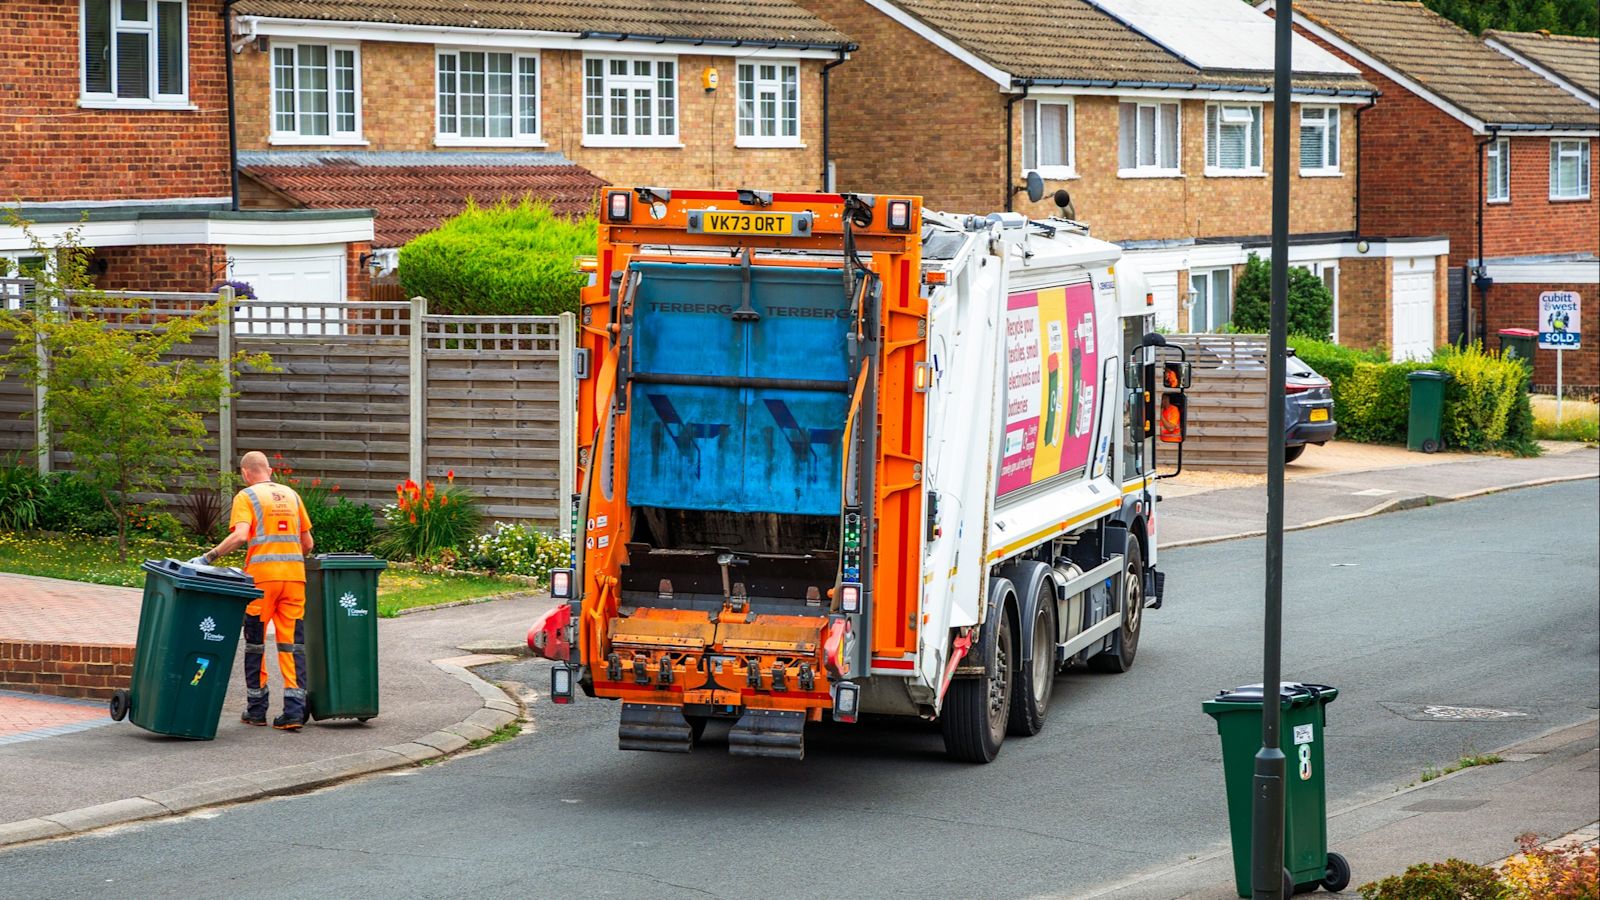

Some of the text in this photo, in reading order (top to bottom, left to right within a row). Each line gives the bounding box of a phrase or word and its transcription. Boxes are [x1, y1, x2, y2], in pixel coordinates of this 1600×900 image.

[710, 215, 785, 232] VK73 ORT
[1542, 292, 1572, 303] cubitt
[650, 302, 734, 315] TERBERG
[766, 306, 851, 320] TERBERG
[1552, 302, 1577, 311] west
[1545, 333, 1575, 343] SOLD
[1031, 365, 1040, 385] and
[190, 656, 210, 686] 7
[1298, 743, 1312, 780] 8
